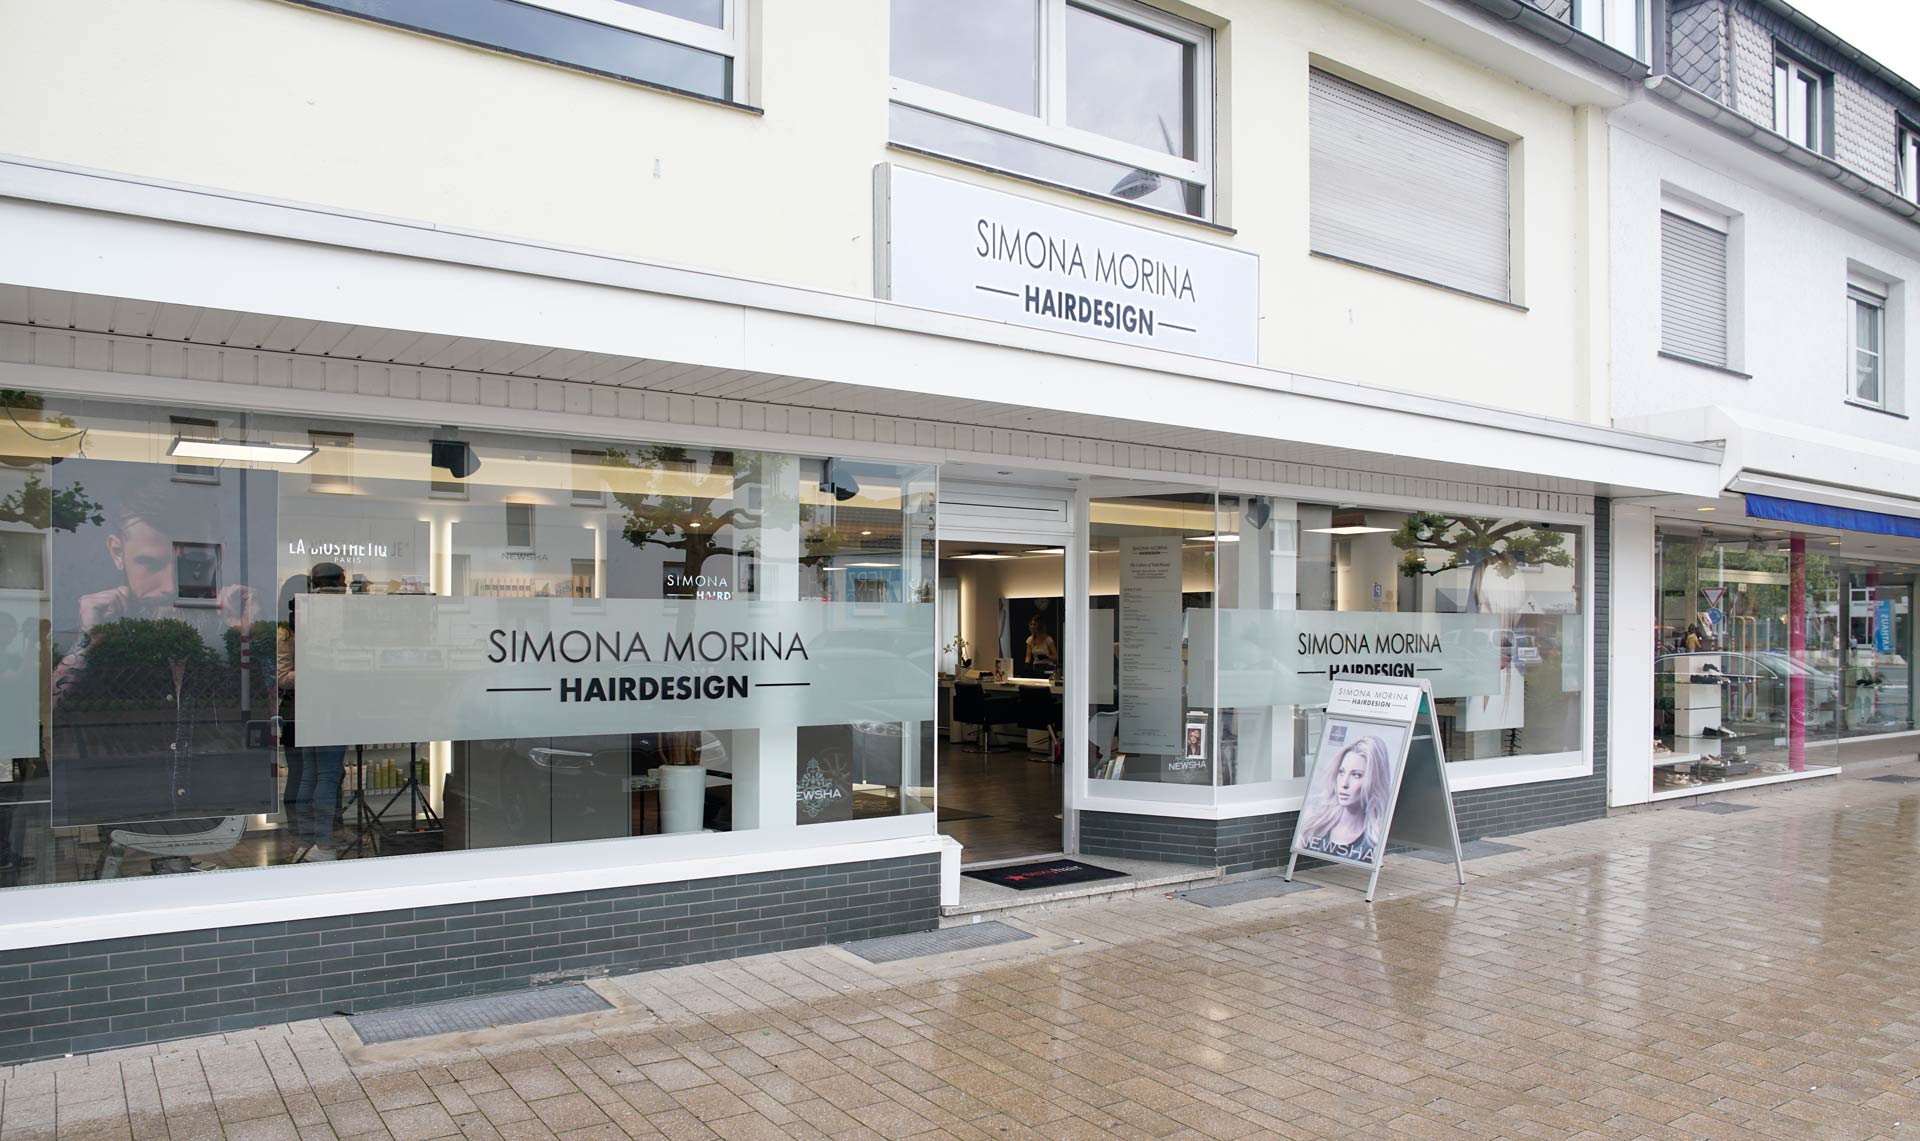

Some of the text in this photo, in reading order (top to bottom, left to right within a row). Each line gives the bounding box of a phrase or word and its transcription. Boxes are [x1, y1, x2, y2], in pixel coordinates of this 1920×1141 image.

[976, 218, 1196, 303] SIMONA MORINA
[1025, 284, 1154, 337] HAIRDESIGN
[288, 538, 306, 555] LA
[334, 556, 362, 564] PARIS
[501, 551, 549, 561] NEWSHA
[666, 574, 728, 587] SIMONA
[696, 591, 733, 600] HAIRD
[488, 629, 809, 663] SIMONA MORINA
[1298, 632, 1442, 655] SIMONA MORINA
[560, 675, 749, 702] HAIRDESIGN
[1337, 687, 1409, 701] SIMONA MORINA
[1351, 698, 1391, 708] HAIRDESIGN
[1168, 760, 1207, 771] NEWSHA
[796, 788, 842, 801] EWSHA
[1299, 836, 1376, 864] NEWSHA
